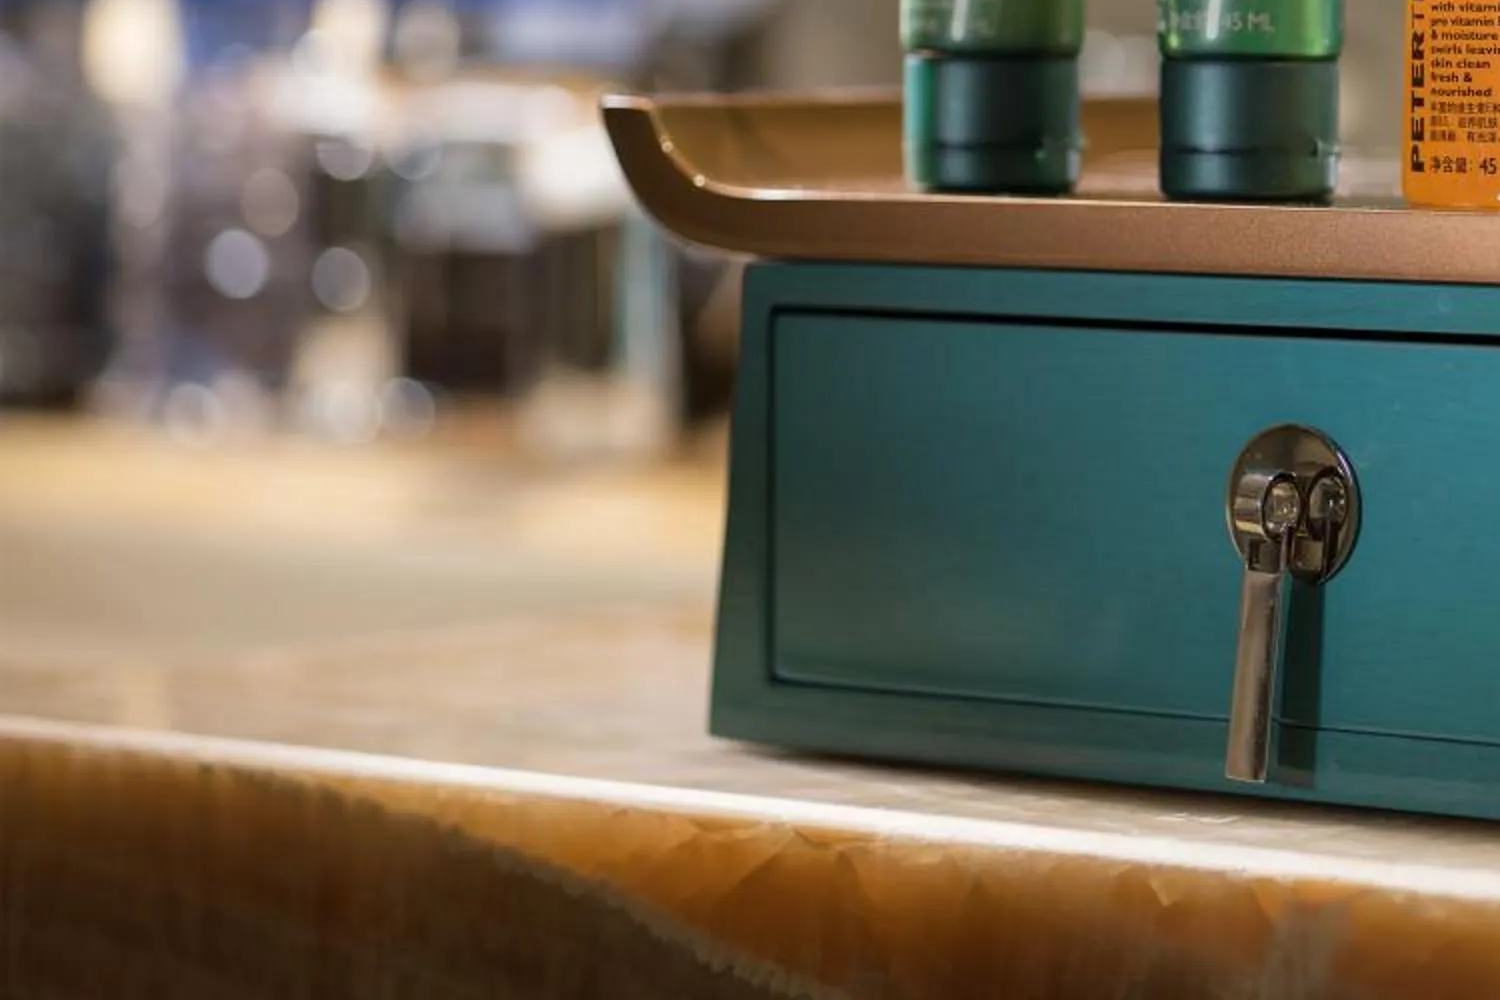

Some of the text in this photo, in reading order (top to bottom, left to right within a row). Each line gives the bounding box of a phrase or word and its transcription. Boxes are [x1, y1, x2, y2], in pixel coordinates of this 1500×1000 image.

[1430, 1, 1454, 12] with
[1450, 16, 1494, 26] vitamin
[1441, 31, 1499, 41] moisture
[1431, 58, 1490, 69] skin clean
[1463, 73, 1472, 82] &
[1430, 86, 1492, 97] nourished
[1480, 158, 1497, 174] 45
